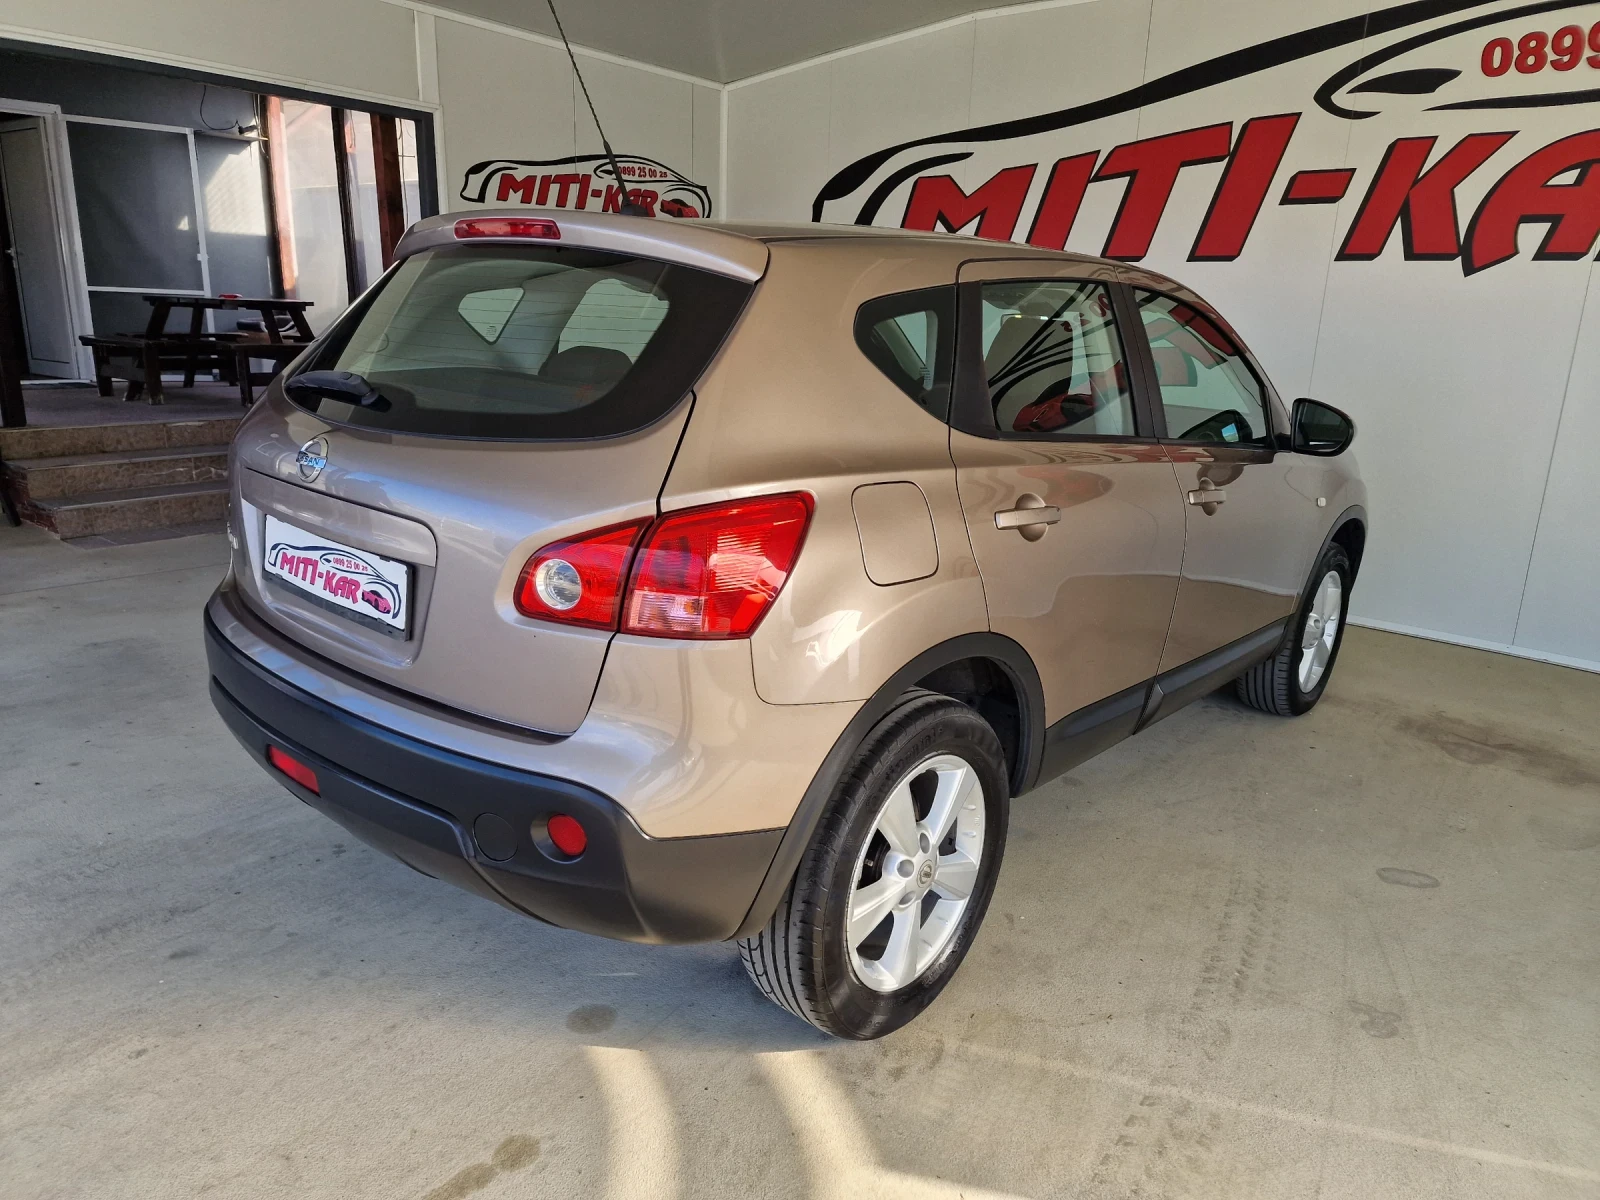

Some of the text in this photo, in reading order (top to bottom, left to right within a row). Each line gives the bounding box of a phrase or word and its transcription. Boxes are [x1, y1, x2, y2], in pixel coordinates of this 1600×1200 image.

[637, 166, 647, 178] 25
[648, 168, 658, 178] 00
[659, 170, 668, 178] 25
[900, 111, 1600, 278] MITI-KA
[280, 551, 361, 604] MITI-KAR
[345, 559, 353, 569] 25
[353, 561, 360, 571] 00
